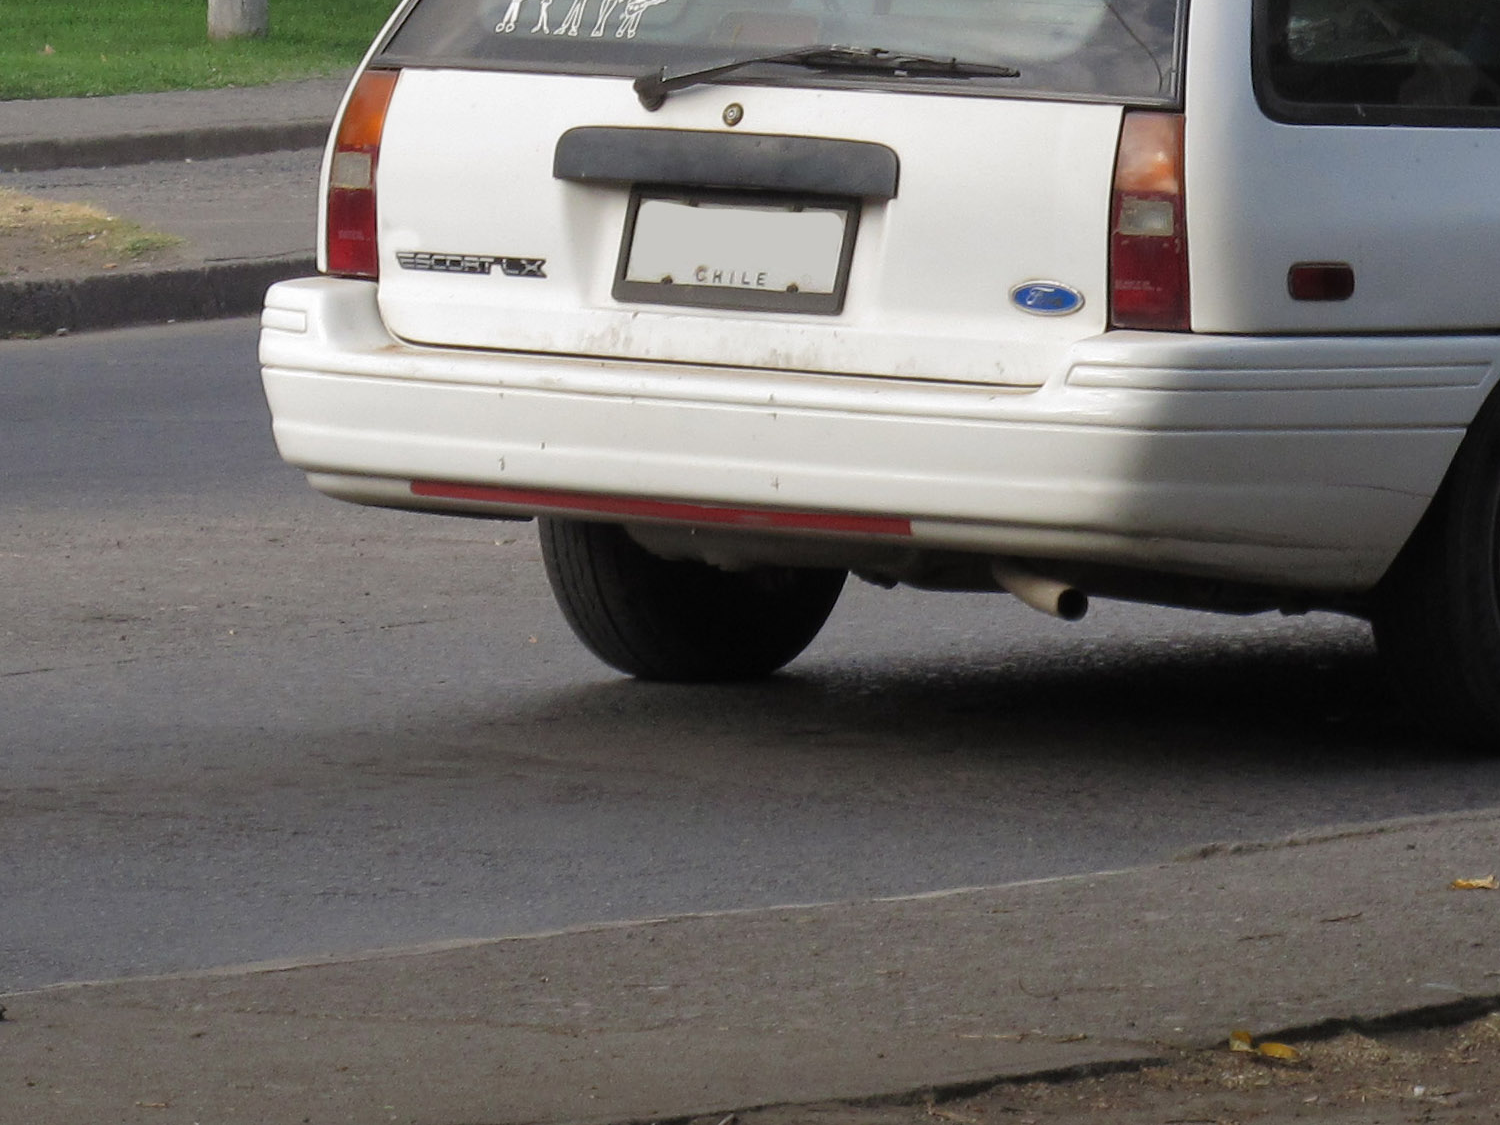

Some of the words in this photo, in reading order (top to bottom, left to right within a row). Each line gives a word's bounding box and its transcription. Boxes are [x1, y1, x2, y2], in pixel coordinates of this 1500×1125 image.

[397, 252, 495, 274] ESCORT
[502, 258, 546, 276] LX
[694, 264, 769, 287] CHILE
